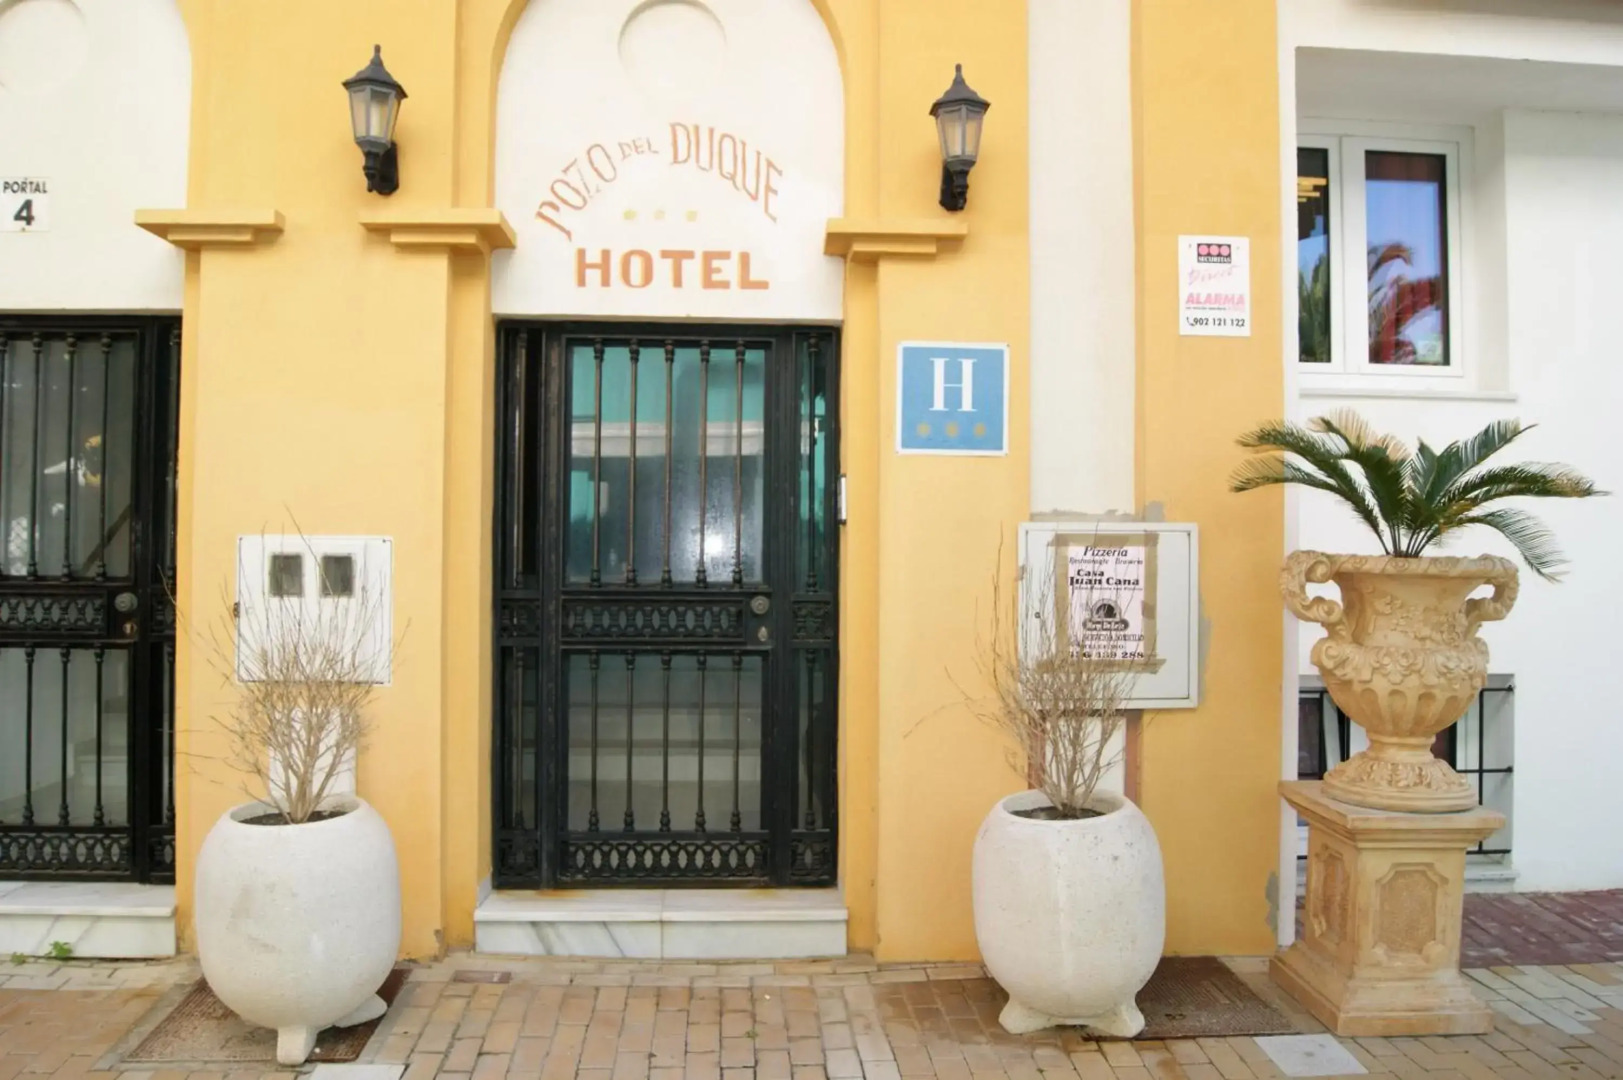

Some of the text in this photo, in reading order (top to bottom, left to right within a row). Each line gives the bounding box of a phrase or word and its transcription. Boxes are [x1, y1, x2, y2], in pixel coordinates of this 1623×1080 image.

[617, 137, 659, 161] DEL
[669, 121, 783, 223] DUQUE
[3, 181, 48, 194] PORTAL
[13, 199, 35, 226] 4
[575, 248, 770, 290] HOTEL
[1185, 293, 1246, 305] ALARMA
[1194, 317, 1246, 327] 902 121 122
[928, 357, 978, 413] H
[1077, 569, 1104, 577] Casa
[1070, 577, 1139, 586] Juan Cana
